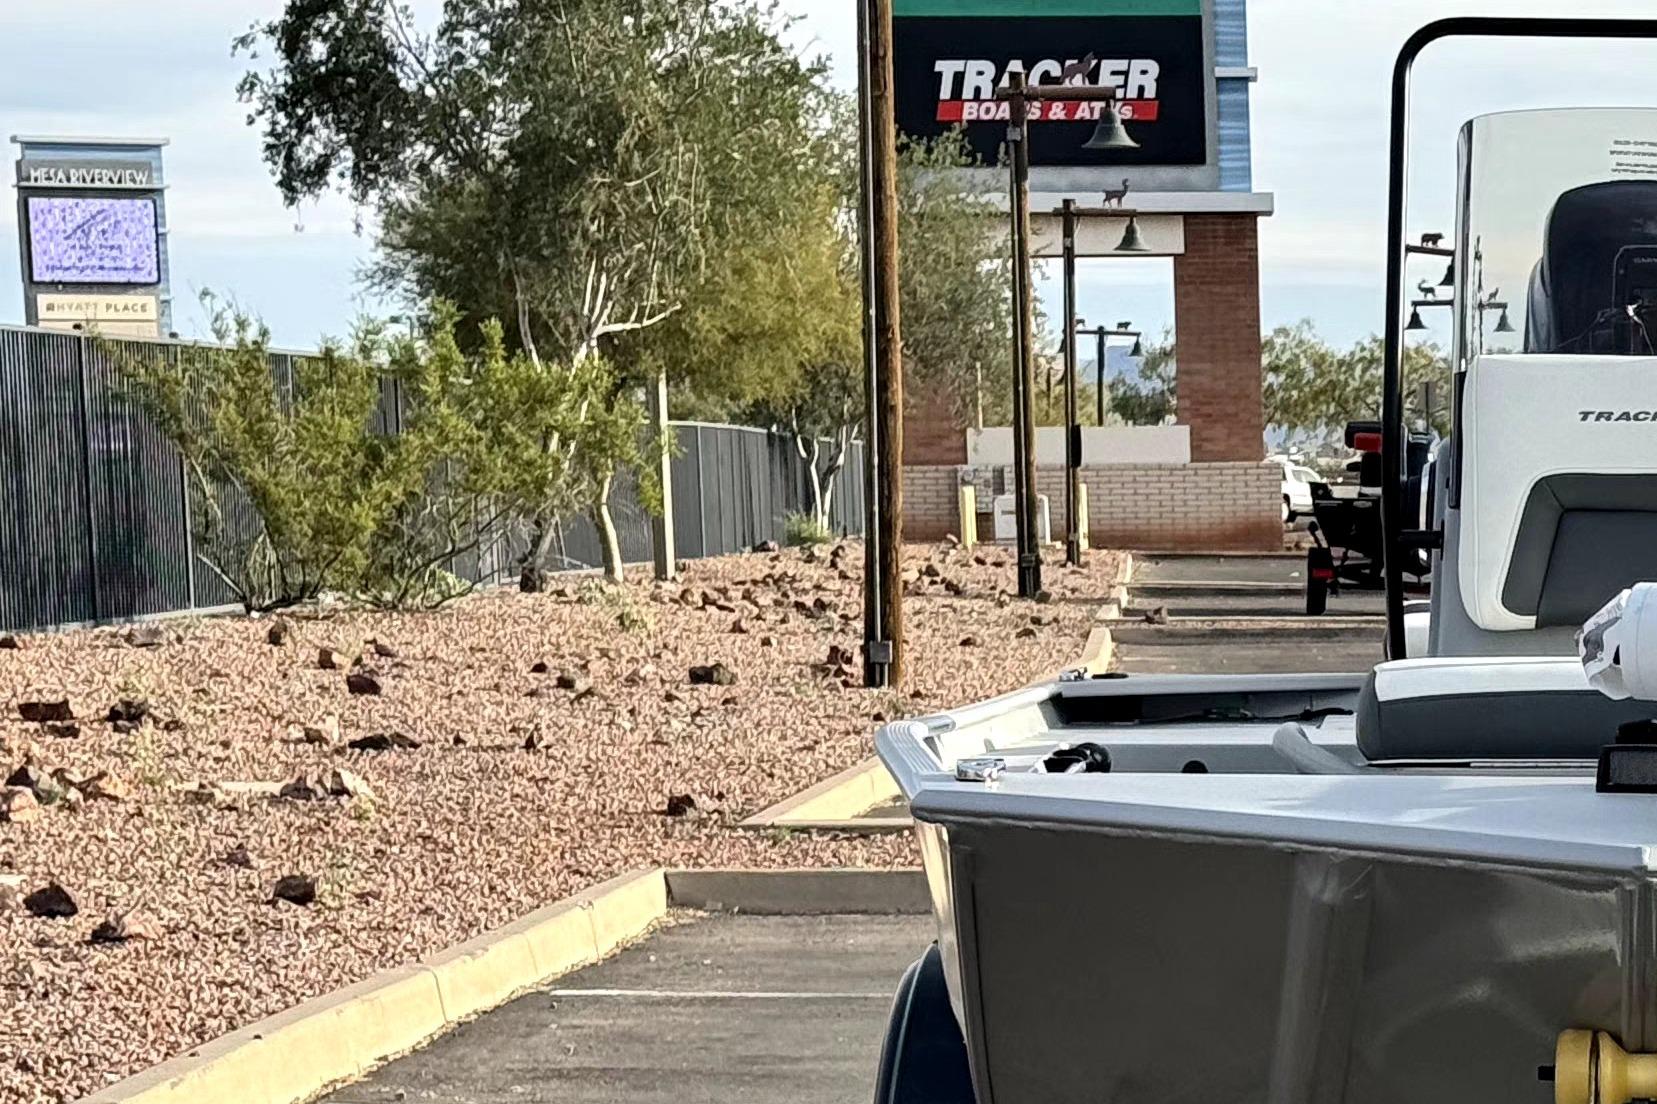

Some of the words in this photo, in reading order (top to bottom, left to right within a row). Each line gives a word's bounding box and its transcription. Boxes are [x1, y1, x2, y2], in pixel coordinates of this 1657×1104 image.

[963, 101, 1042, 120] BOAS
[1048, 102, 1066, 119] &
[29, 168, 67, 184] MESA
[69, 168, 149, 186] RIVERVIEW
[56, 302, 98, 312] HYATT
[105, 303, 148, 313] PLACE
